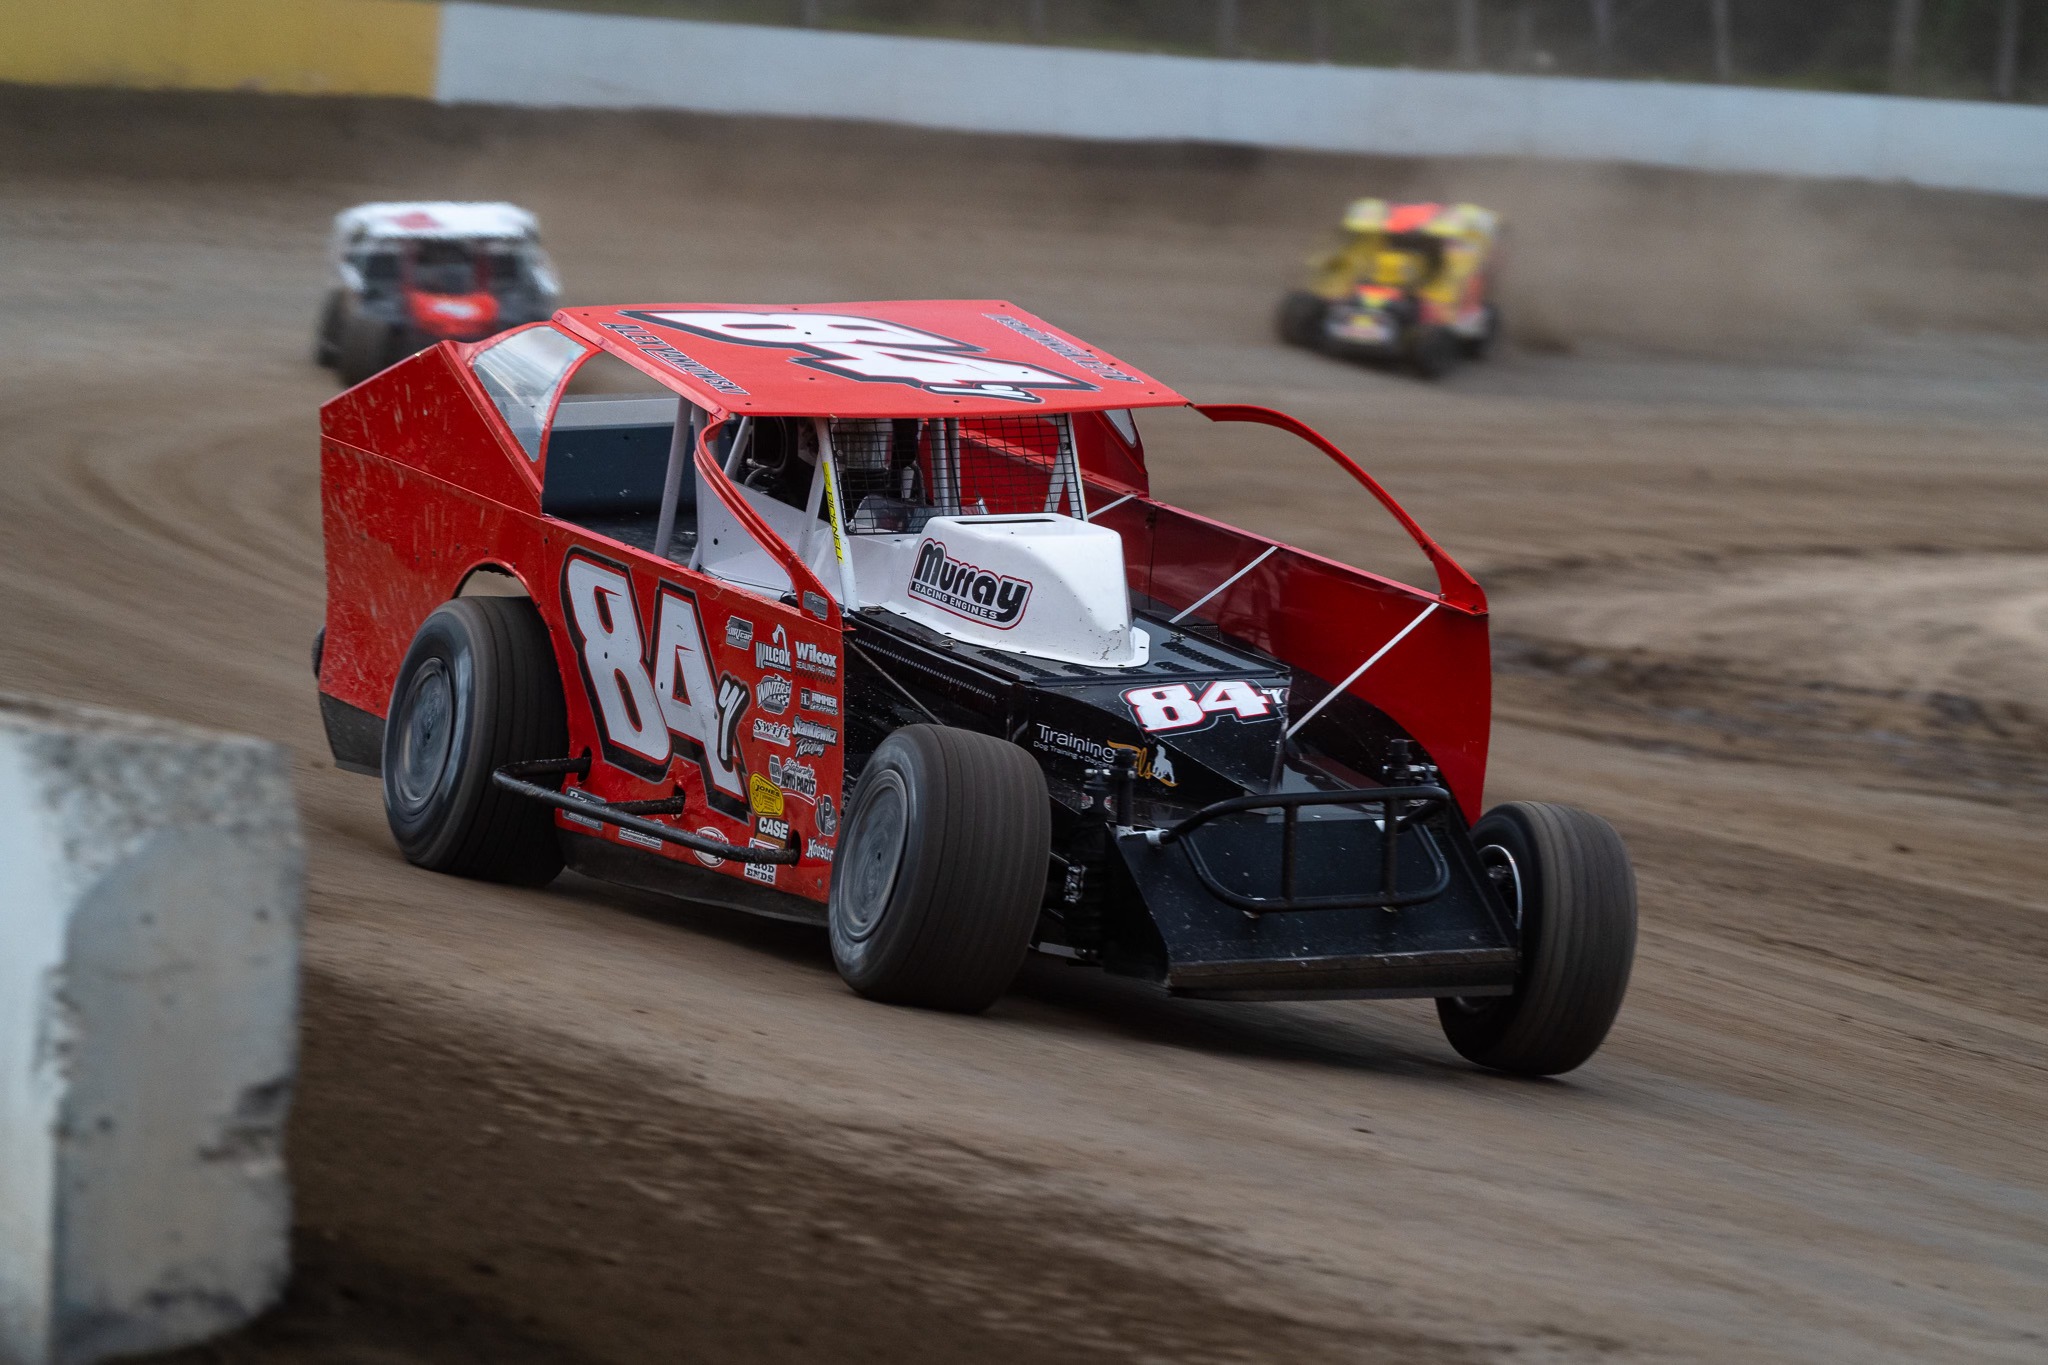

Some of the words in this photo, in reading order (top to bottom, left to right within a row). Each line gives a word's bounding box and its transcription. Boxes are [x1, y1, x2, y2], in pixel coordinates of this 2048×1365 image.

[913, 543, 1028, 622] Murray
[913, 582, 948, 602] RACING
[949, 599, 998, 620] ENGINES
[795, 641, 837, 668] Wilcox
[756, 681, 791, 707] WINTERS
[753, 719, 791, 739] Swift
[1033, 740, 1049, 752] Dog
[1050, 745, 1078, 760] Training
[1036, 723, 1116, 763] Training
[755, 784, 780, 797] JONES
[758, 817, 789, 840] CASE
[746, 867, 774, 883] ENDS
